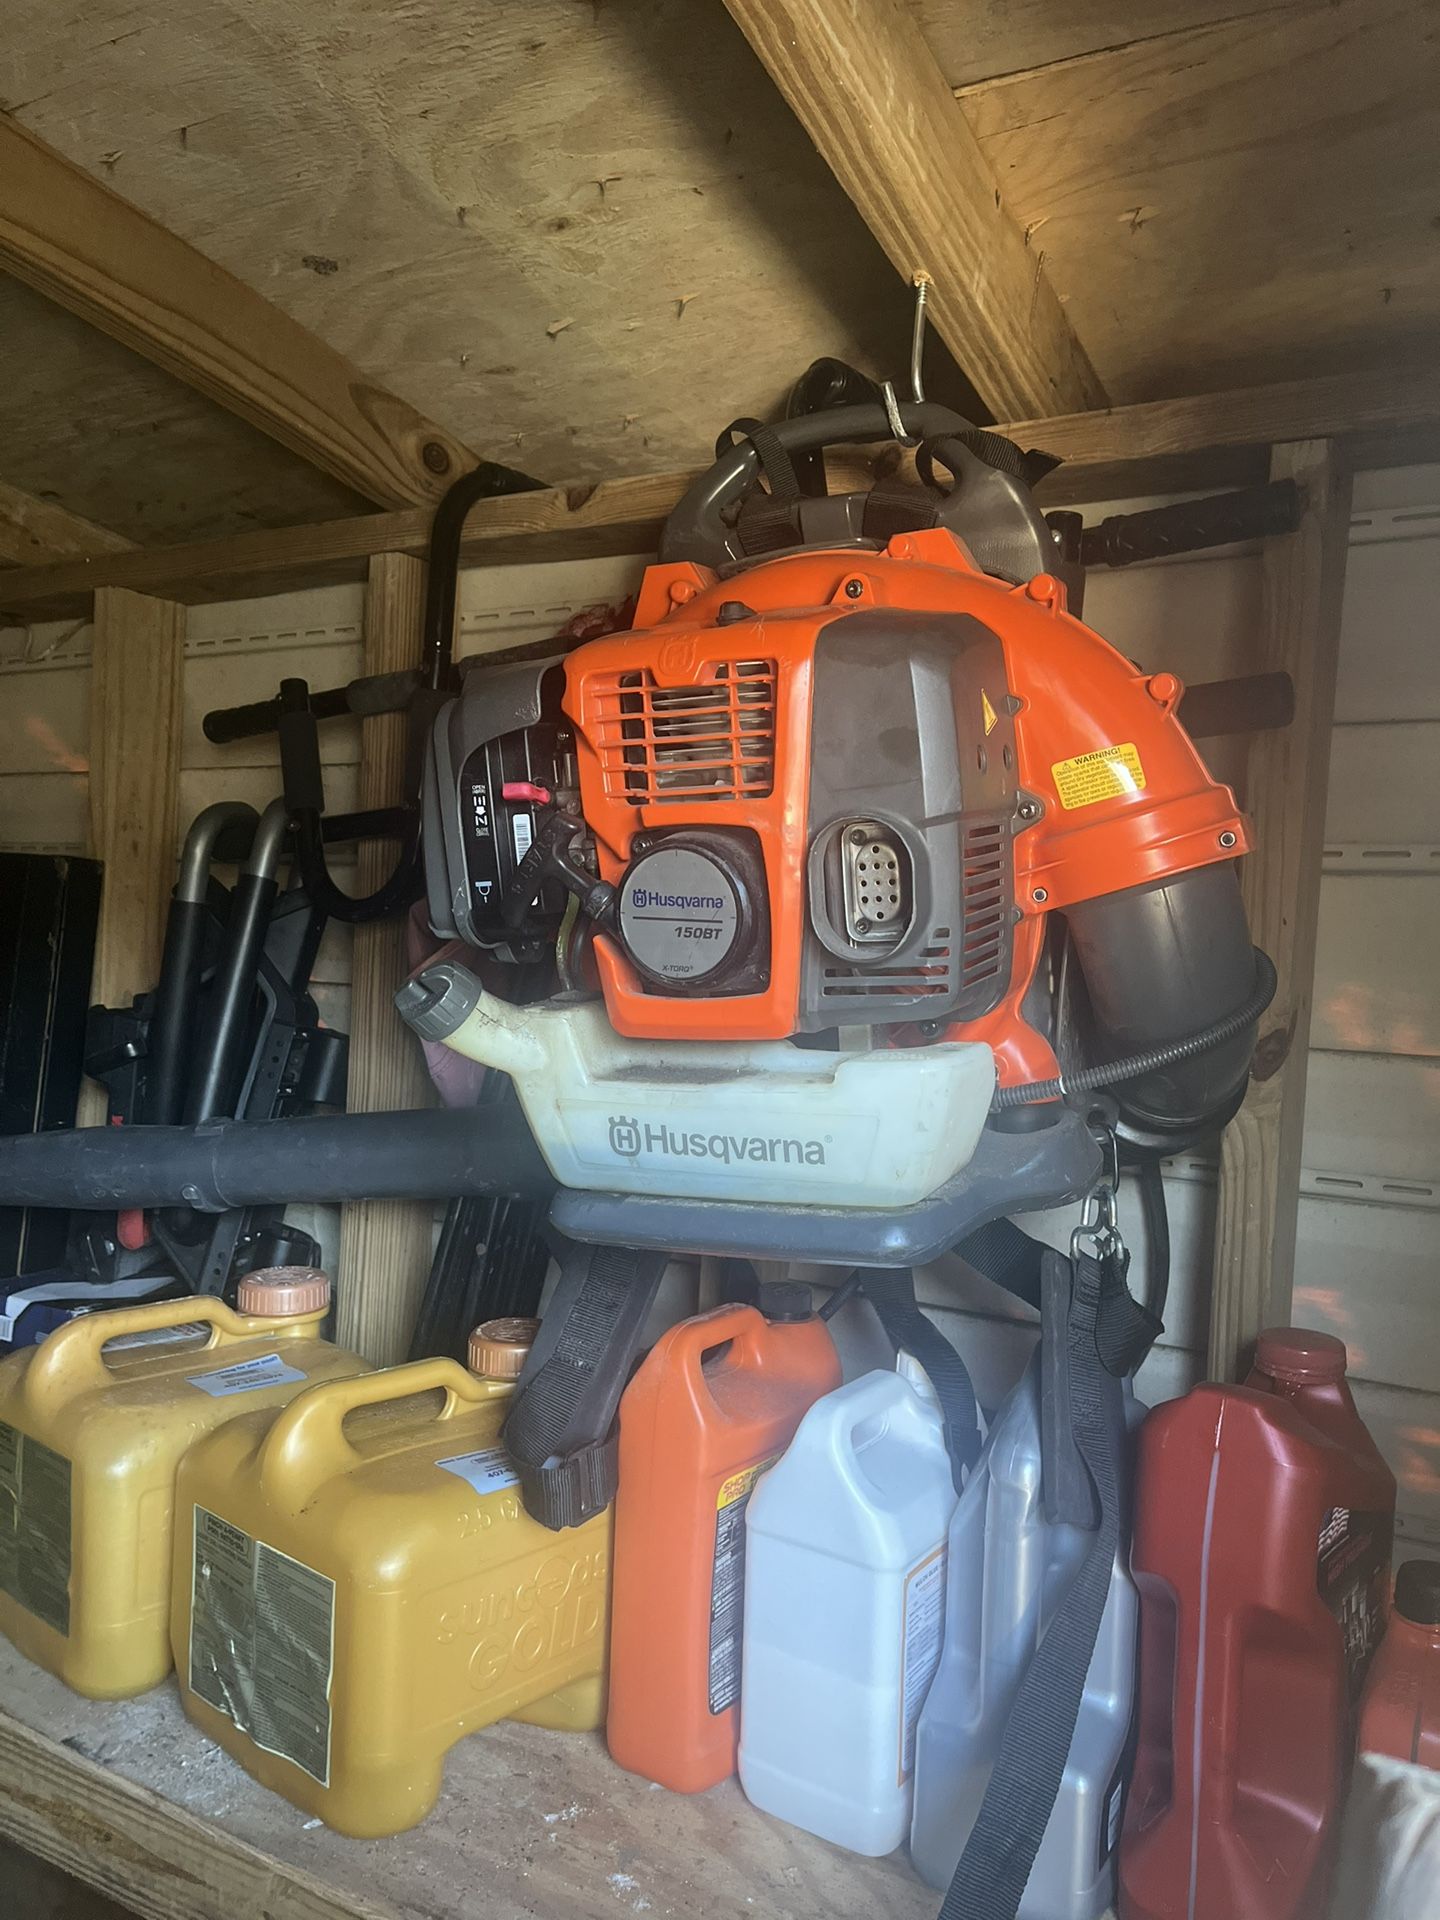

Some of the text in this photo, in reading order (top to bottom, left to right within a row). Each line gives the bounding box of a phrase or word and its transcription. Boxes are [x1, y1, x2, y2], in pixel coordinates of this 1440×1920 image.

[1074, 747, 1121, 765] WARNING!
[648, 892, 724, 909] Husqvarna
[674, 926, 723, 940] 150BT
[662, 964, 690, 973] X-TORQ
[644, 1123, 826, 1165] Husqvarna
[723, 1471, 751, 1495] SHOP
[725, 1484, 746, 1503] PRO
[467, 1591, 600, 1691] GOLD
